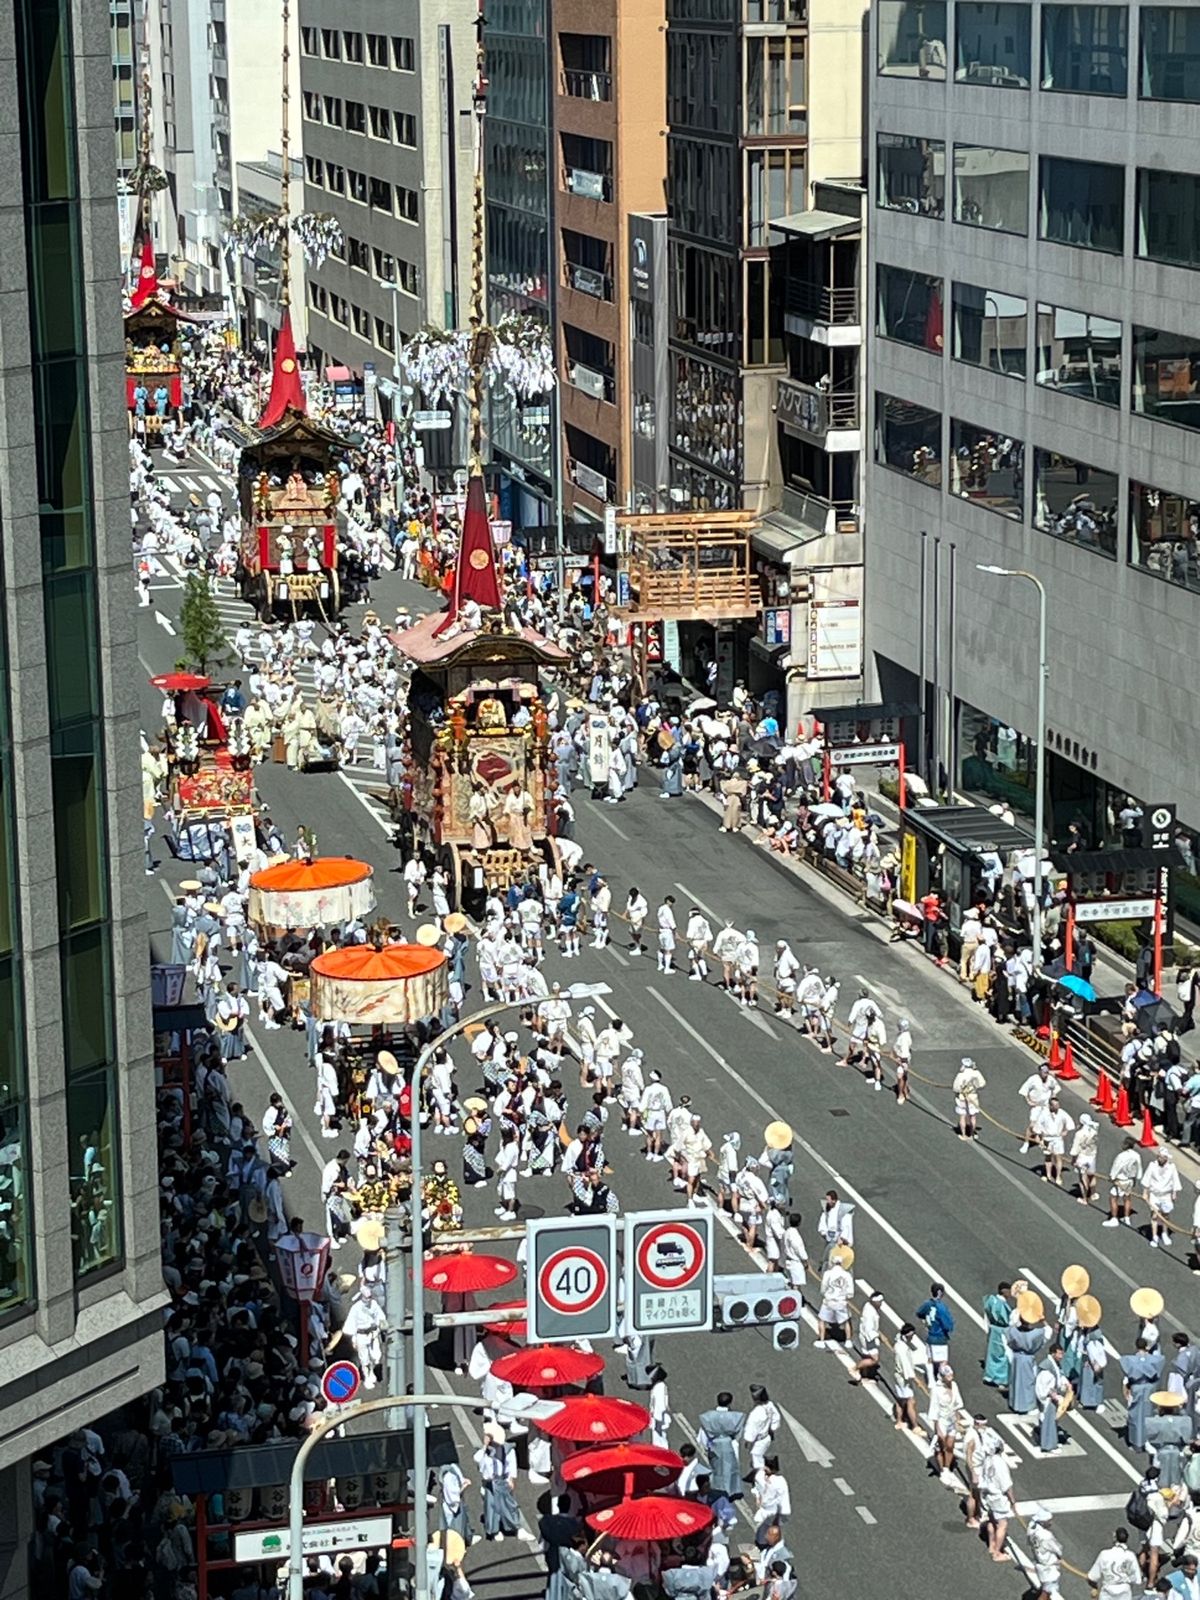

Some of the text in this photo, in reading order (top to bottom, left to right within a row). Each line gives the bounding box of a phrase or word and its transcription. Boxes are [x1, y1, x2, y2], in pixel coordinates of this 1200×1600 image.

[555, 1266, 591, 1295] 40
[645, 1295, 689, 1309] 路線バス
